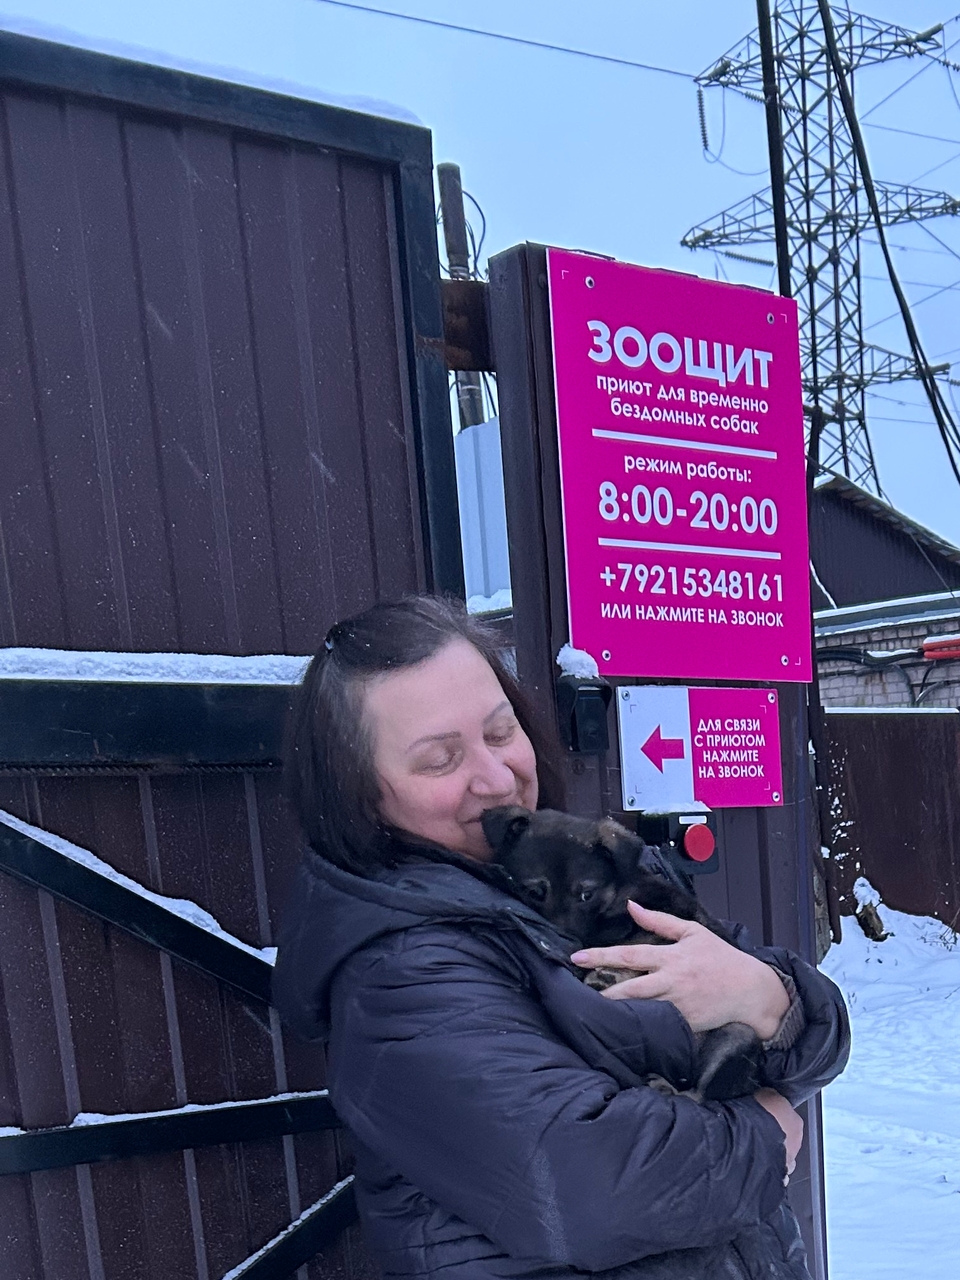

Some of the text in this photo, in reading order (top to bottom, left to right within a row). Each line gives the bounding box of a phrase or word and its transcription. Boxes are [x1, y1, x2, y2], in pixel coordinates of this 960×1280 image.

[587, 320, 773, 388] ЗООЩИТ
[596, 375, 769, 414] приют для временно
[610, 399, 759, 434] бездомных собак
[624, 455, 752, 483] режим работы:
[599, 481, 778, 535] 8:00-20:00
[600, 563, 783, 602] +79215348161
[601, 603, 784, 627] ИЛИ НАЖМИТЕ НА ЗВОНОК
[697, 719, 760, 732] ДЛЯ СВЯЗИ
[694, 734, 766, 747] С ПРИЮТОМ
[703, 750, 759, 763] НАЖМИТЕ
[698, 765, 765, 778] НА ЗВОНОК
